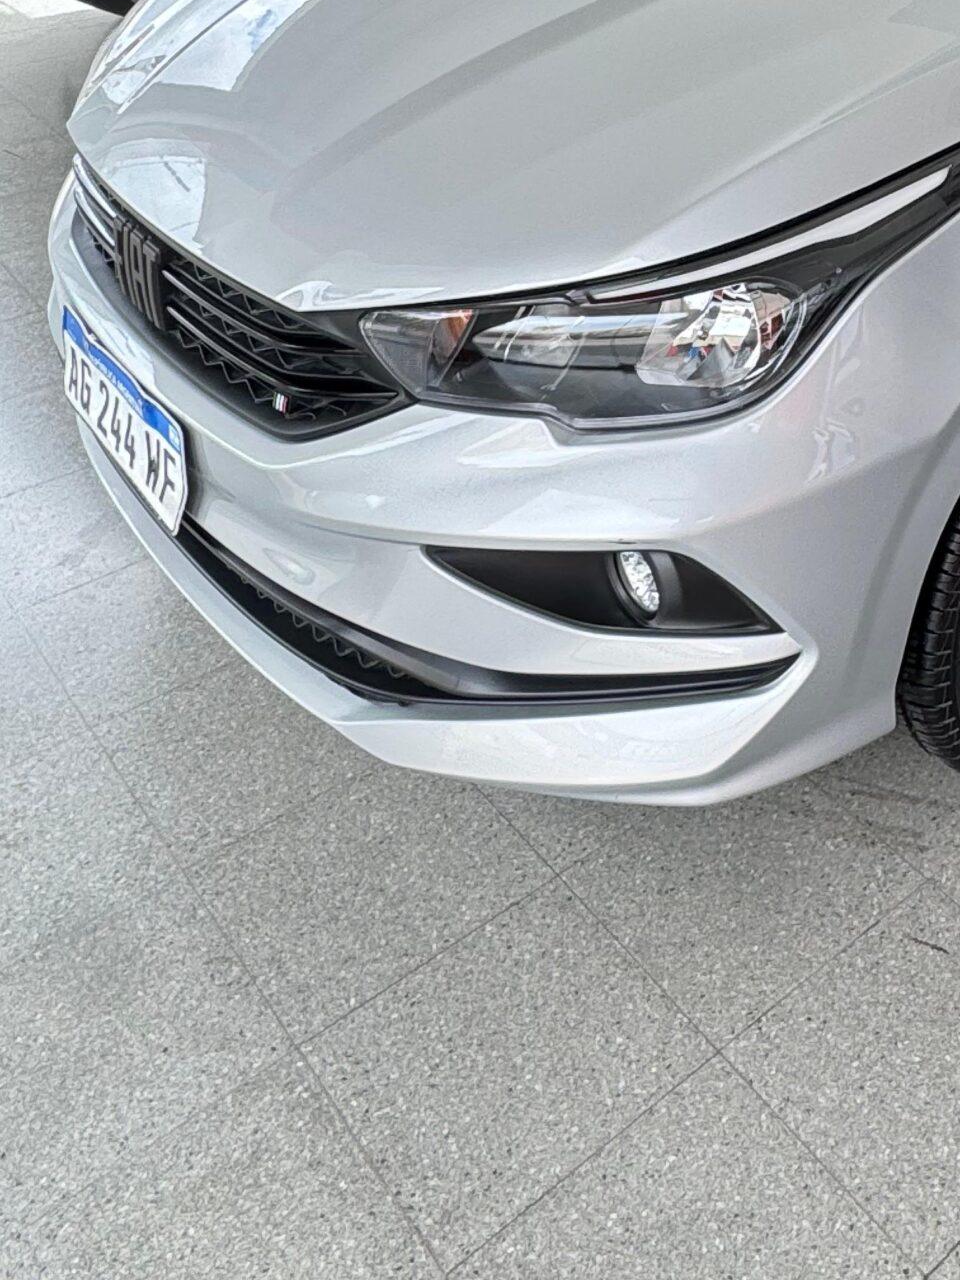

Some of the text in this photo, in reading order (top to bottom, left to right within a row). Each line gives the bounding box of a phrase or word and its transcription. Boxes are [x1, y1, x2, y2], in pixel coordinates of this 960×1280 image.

[114, 214, 161, 329] FIAT
[68, 345, 92, 416] AG
[96, 379, 136, 470] 244
